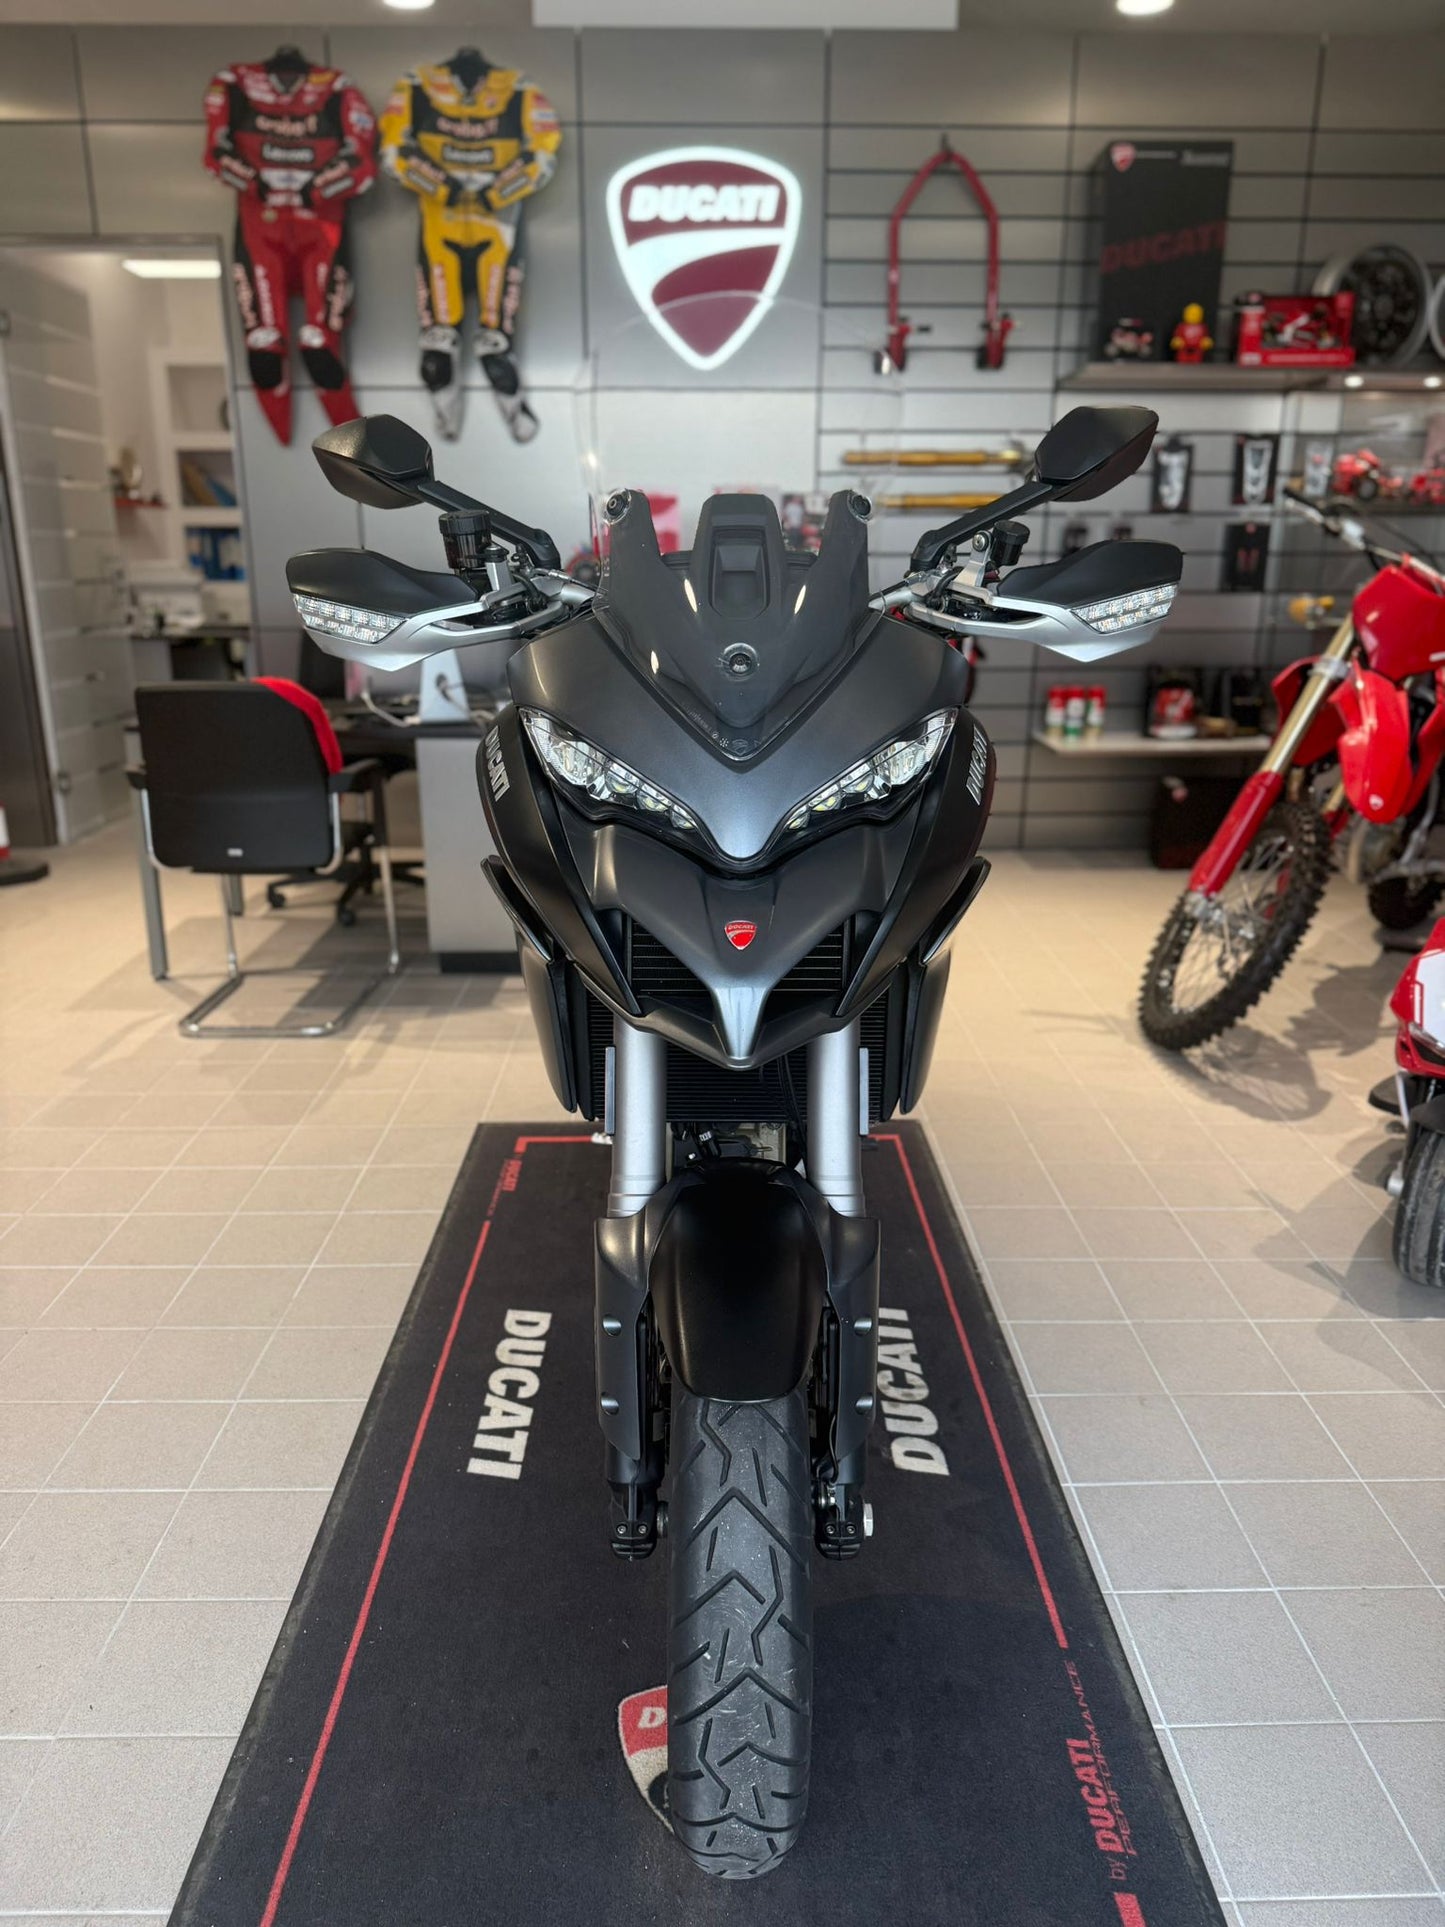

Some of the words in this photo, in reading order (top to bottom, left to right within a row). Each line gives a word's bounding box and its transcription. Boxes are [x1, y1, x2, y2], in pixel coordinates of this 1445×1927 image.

[627, 184, 781, 223] DUCATI
[485, 725, 510, 802] DUCATI
[966, 723, 987, 805] DUCATI
[466, 1309, 552, 1480] DUCATI
[876, 1307, 951, 1476] DUCATI
[1066, 1738, 1125, 1854] DUCATI
[1106, 1856, 1128, 1882] by
